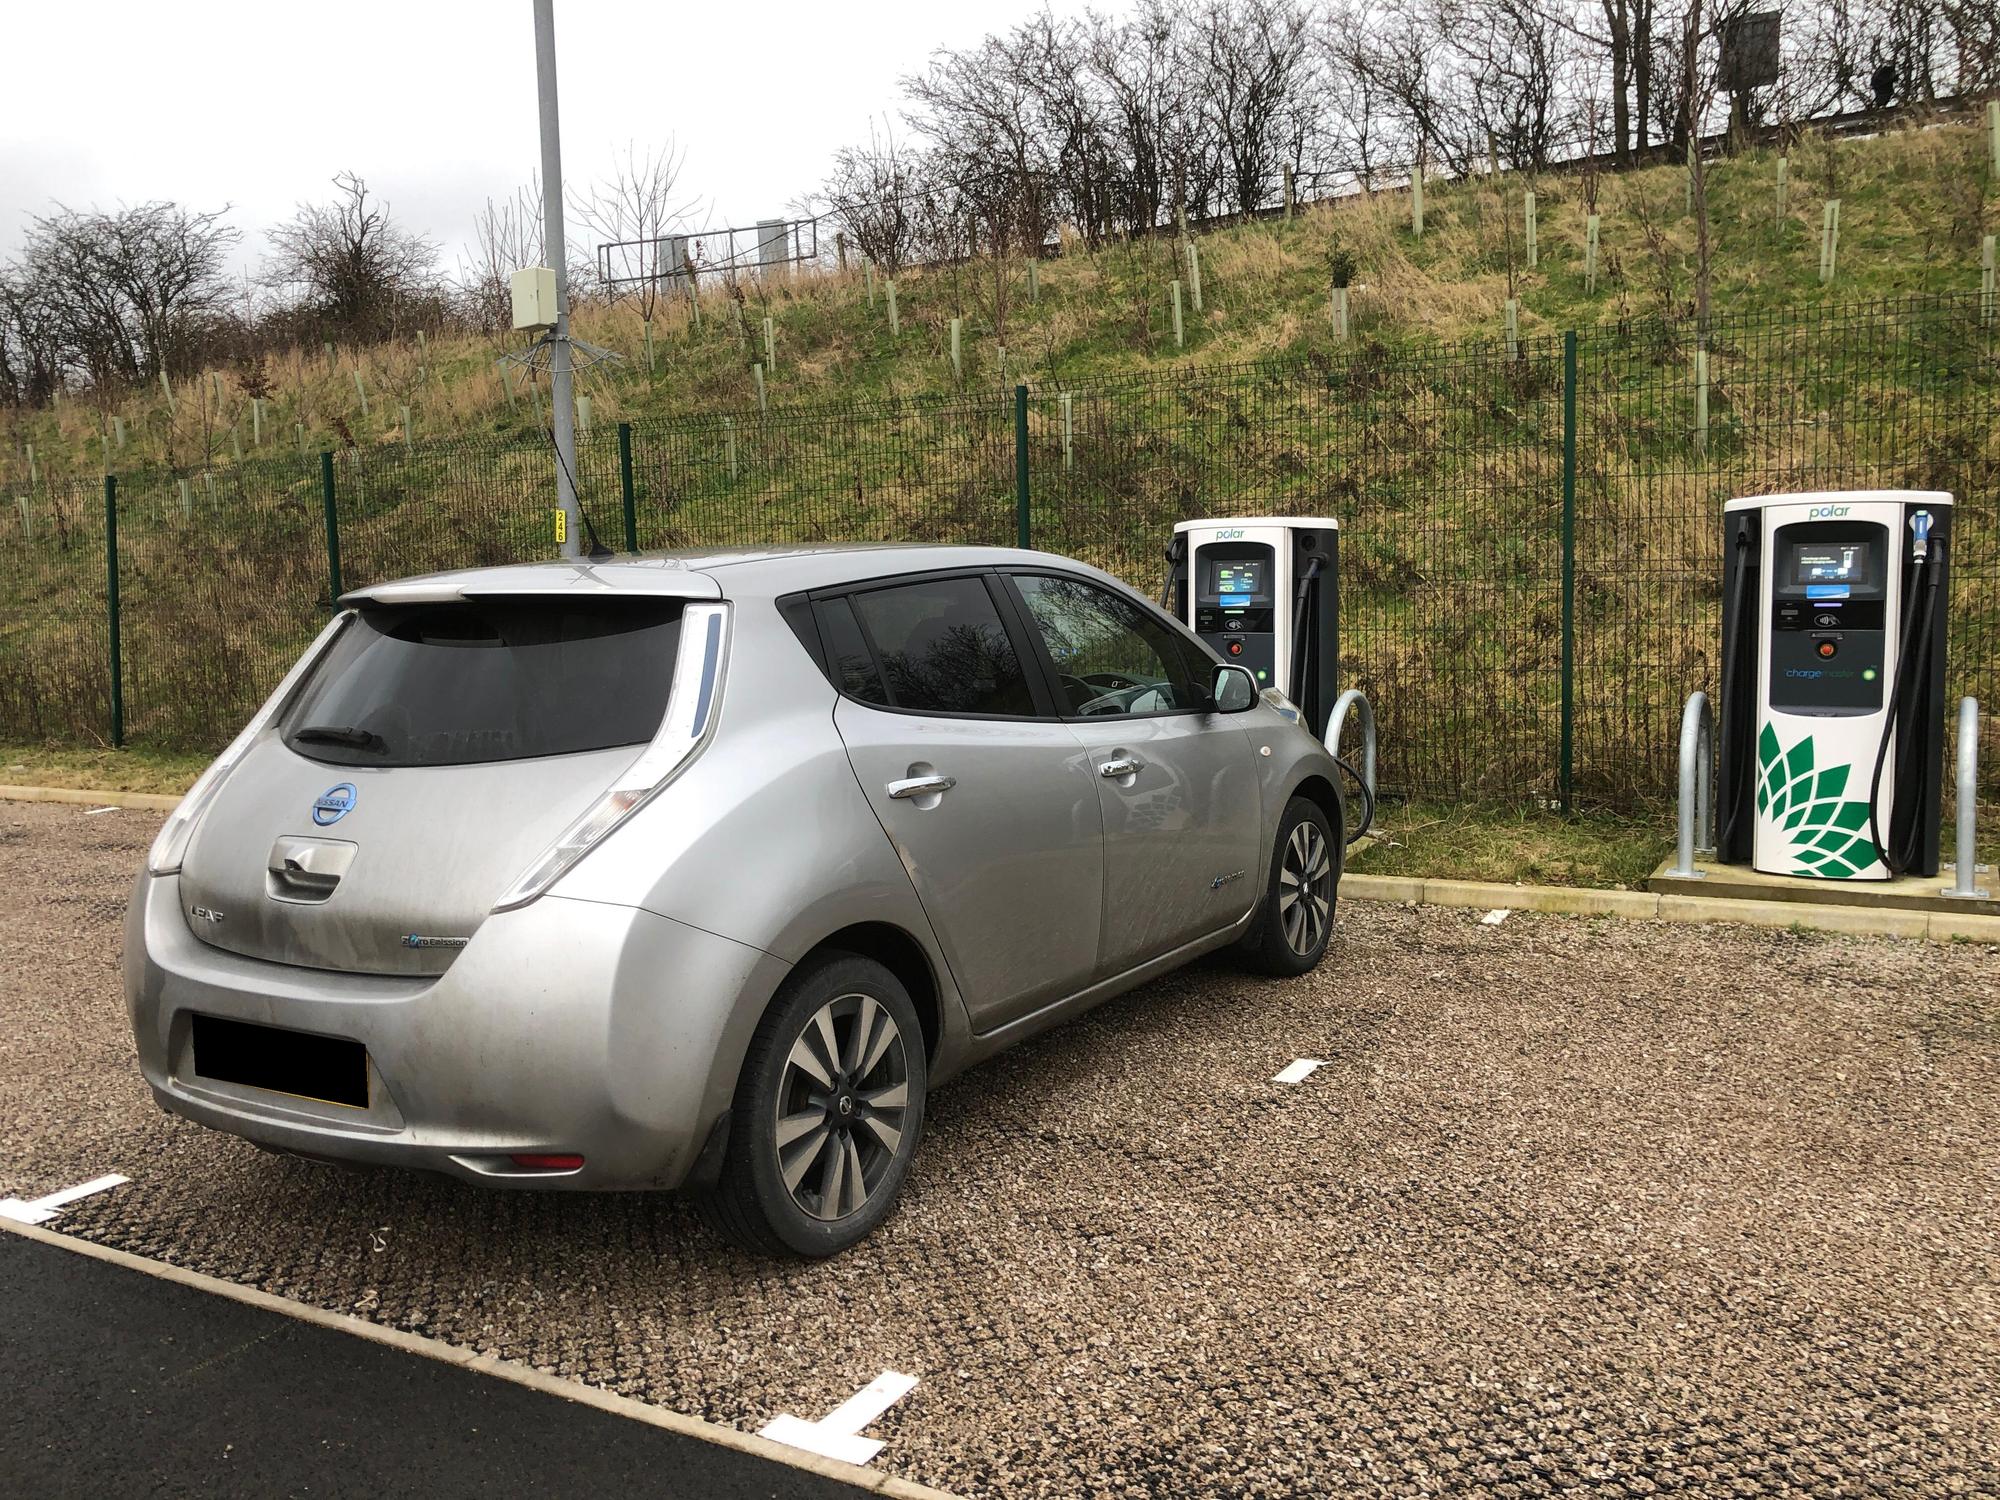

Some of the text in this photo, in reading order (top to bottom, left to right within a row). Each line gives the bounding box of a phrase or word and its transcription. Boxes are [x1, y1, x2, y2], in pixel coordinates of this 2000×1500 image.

[1809, 504, 1850, 520] polar
[1216, 528, 1244, 541] polar
[190, 904, 224, 922] LEAF
